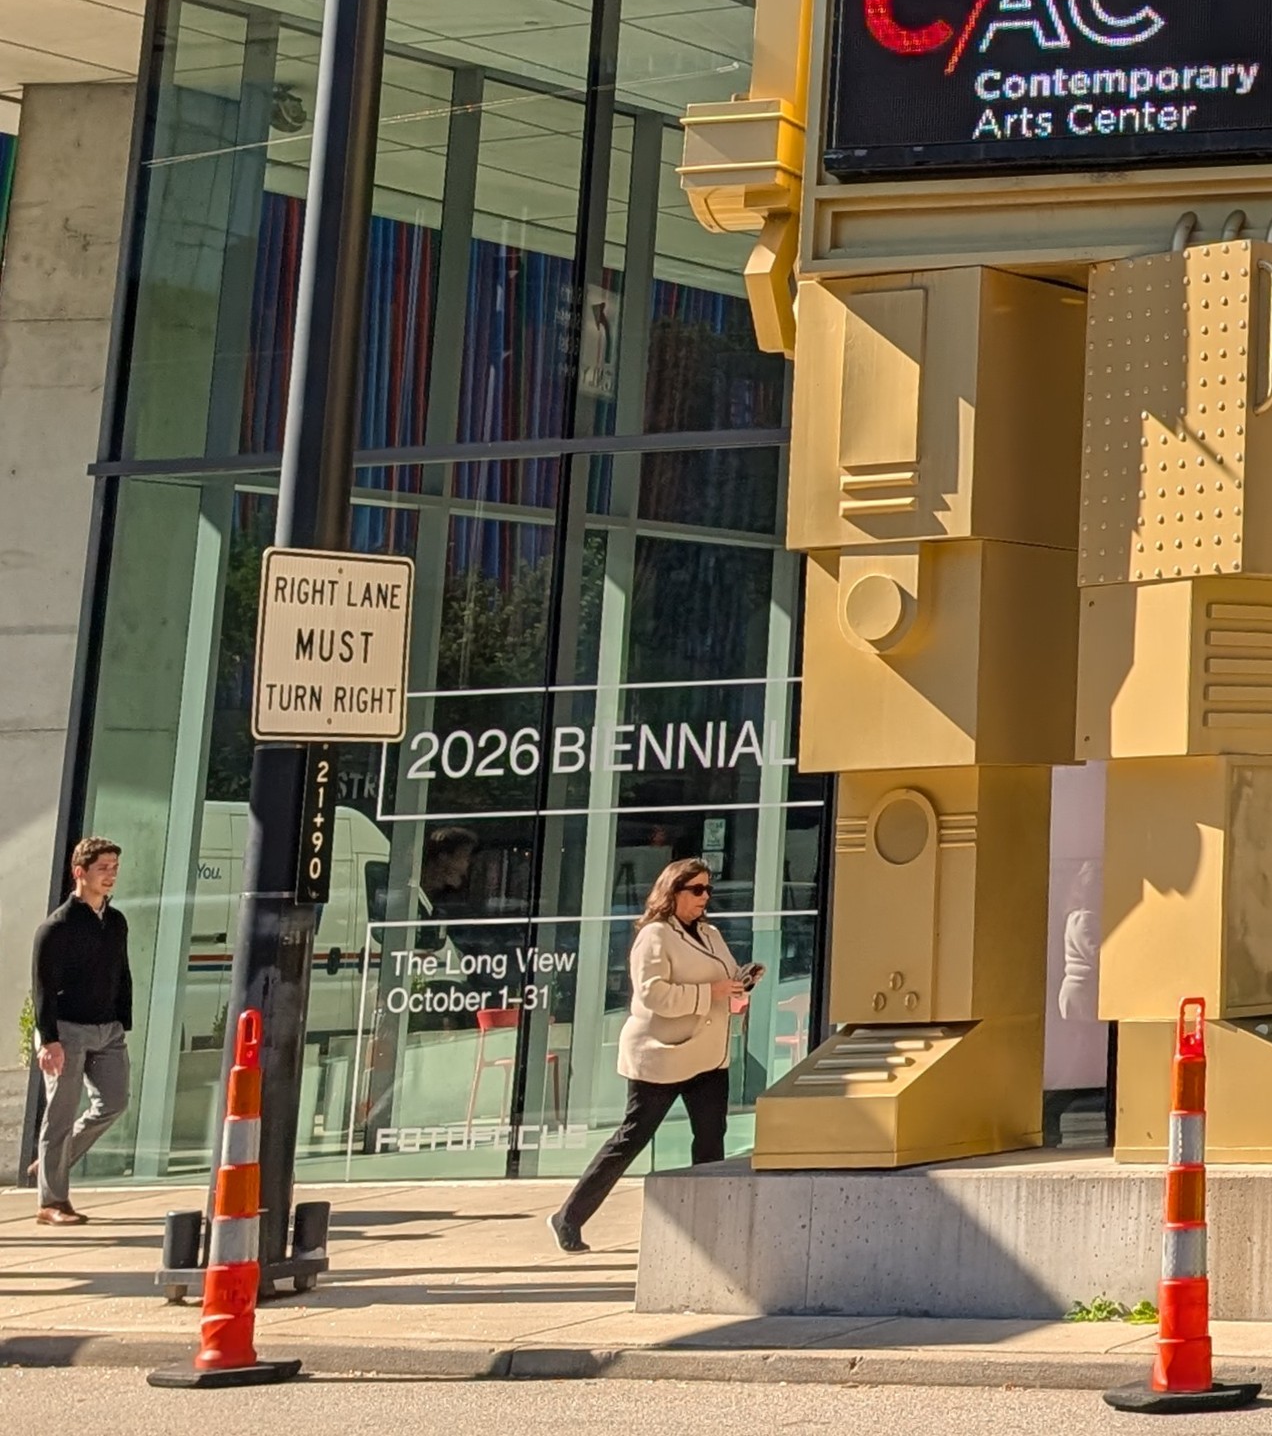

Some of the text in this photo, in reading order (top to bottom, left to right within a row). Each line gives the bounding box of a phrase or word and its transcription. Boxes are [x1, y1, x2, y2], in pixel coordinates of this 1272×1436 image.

[973, 62, 1260, 101] Contemporary
[972, 101, 1198, 140] Arts Center
[274, 576, 401, 610] RIGHT LANE
[295, 627, 373, 664] MUST
[266, 683, 397, 714] TURN RIGHT
[406, 719, 797, 780] 2026 BIENNIAL
[391, 947, 576, 979] The Long View
[387, 985, 491, 1013] October
